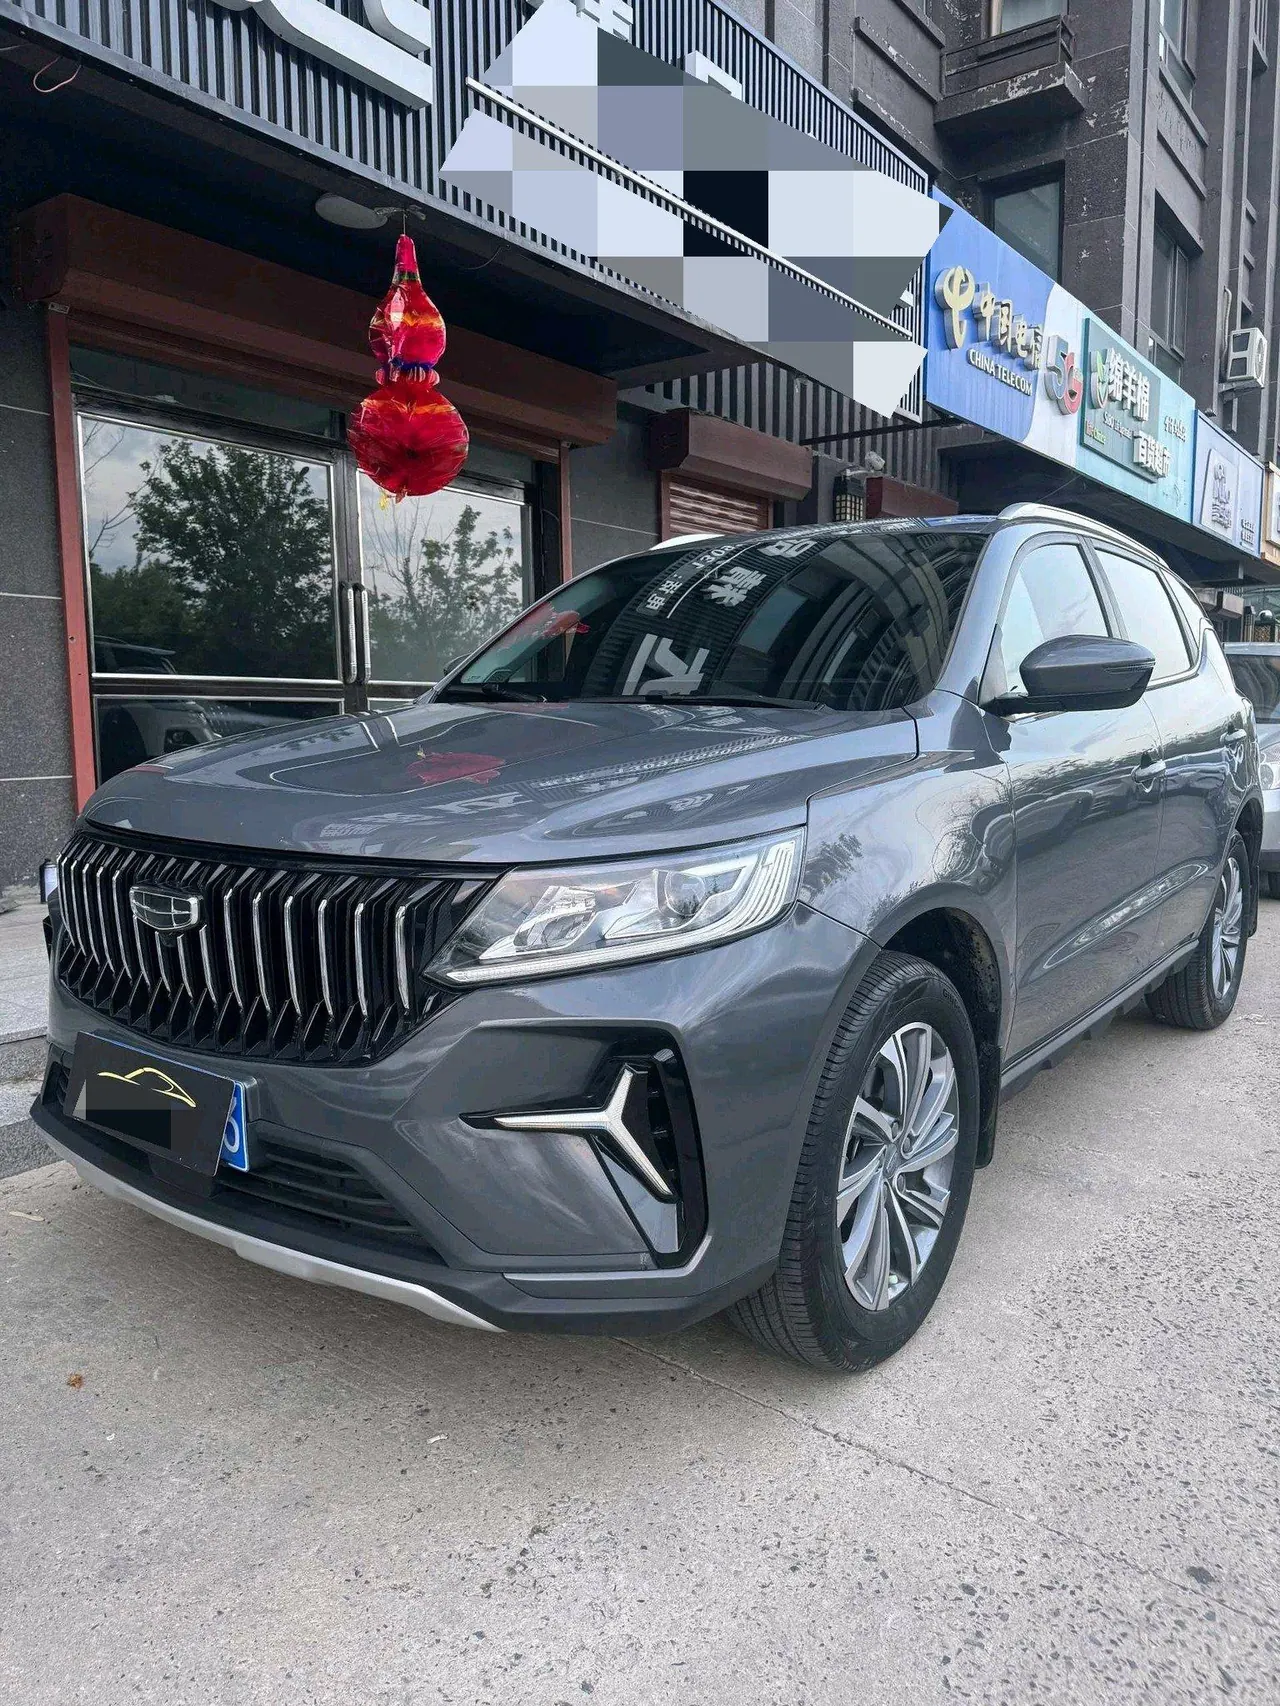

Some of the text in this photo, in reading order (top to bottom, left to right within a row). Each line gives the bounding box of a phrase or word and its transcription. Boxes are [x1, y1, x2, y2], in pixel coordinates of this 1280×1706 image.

[974, 284, 1043, 370] 中国电信
[969, 348, 1033, 397] CHINA TELECOM
[1044, 336, 1084, 415] 5G
